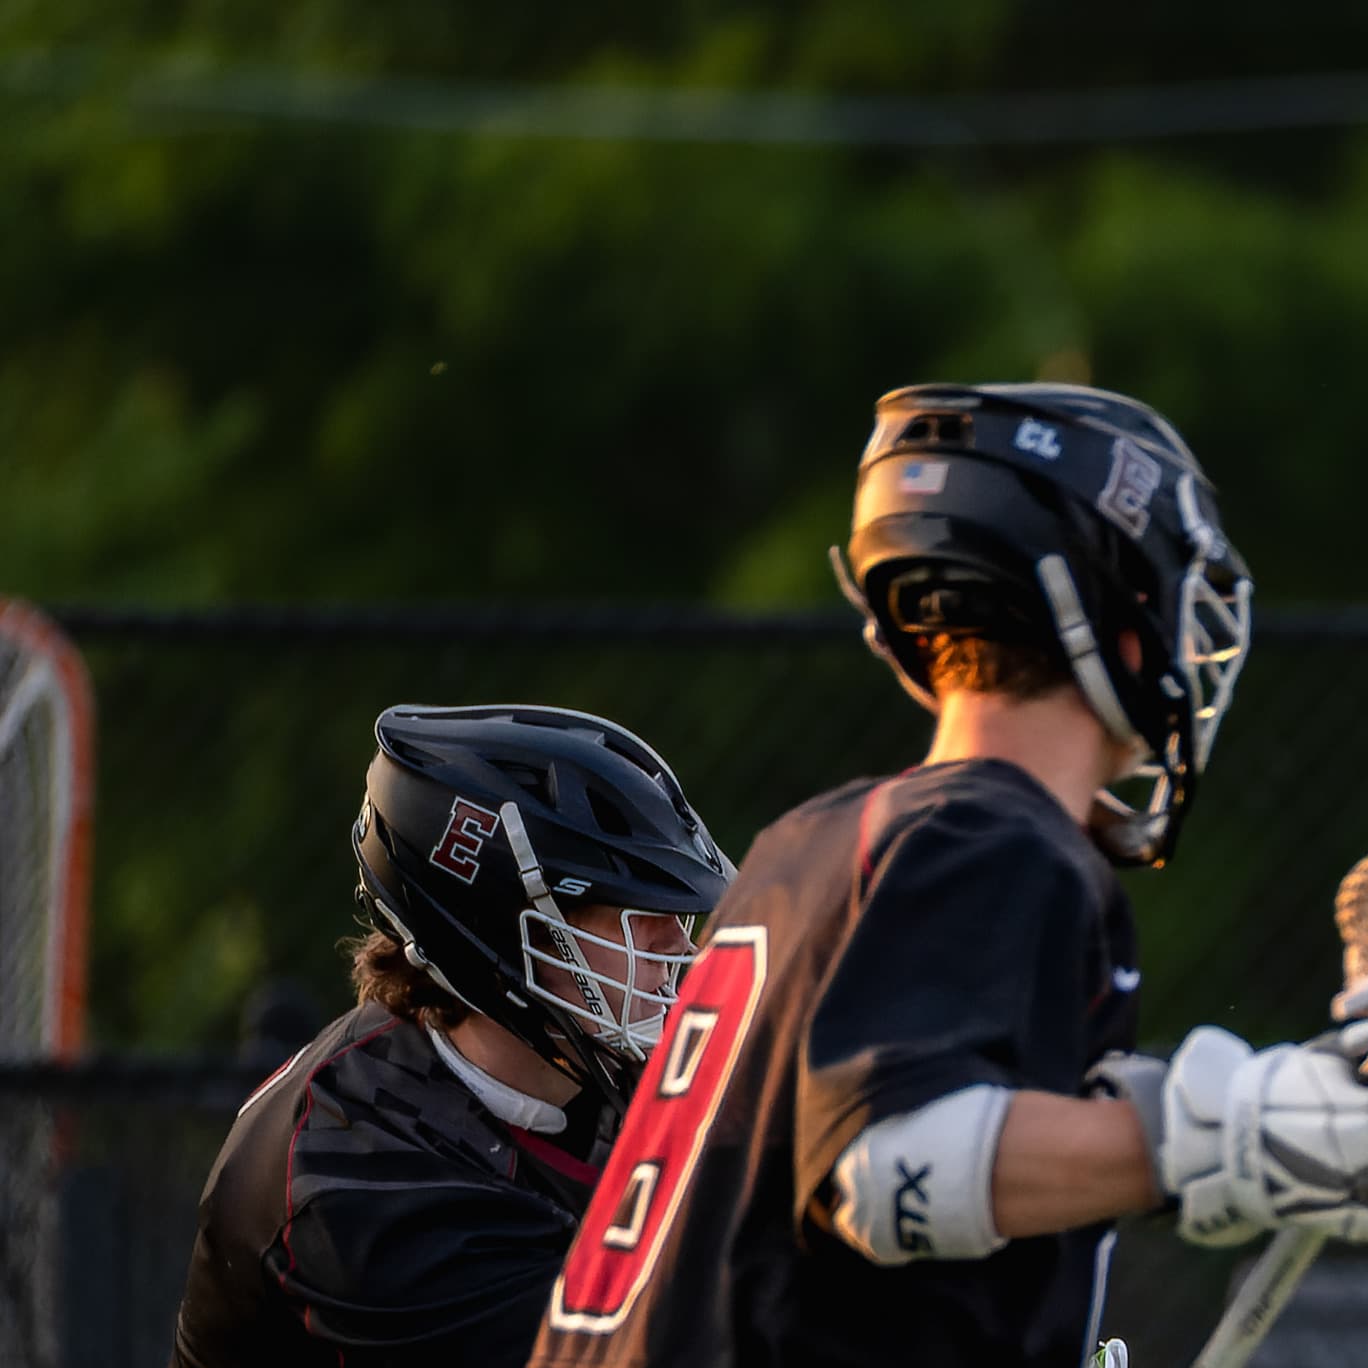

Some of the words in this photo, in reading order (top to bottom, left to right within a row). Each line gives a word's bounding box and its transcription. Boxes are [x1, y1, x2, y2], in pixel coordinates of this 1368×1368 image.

[1097, 435, 1163, 540] E
[429, 796, 500, 885] E
[551, 927, 604, 1017] ascade
[893, 1155, 932, 1253] STX
